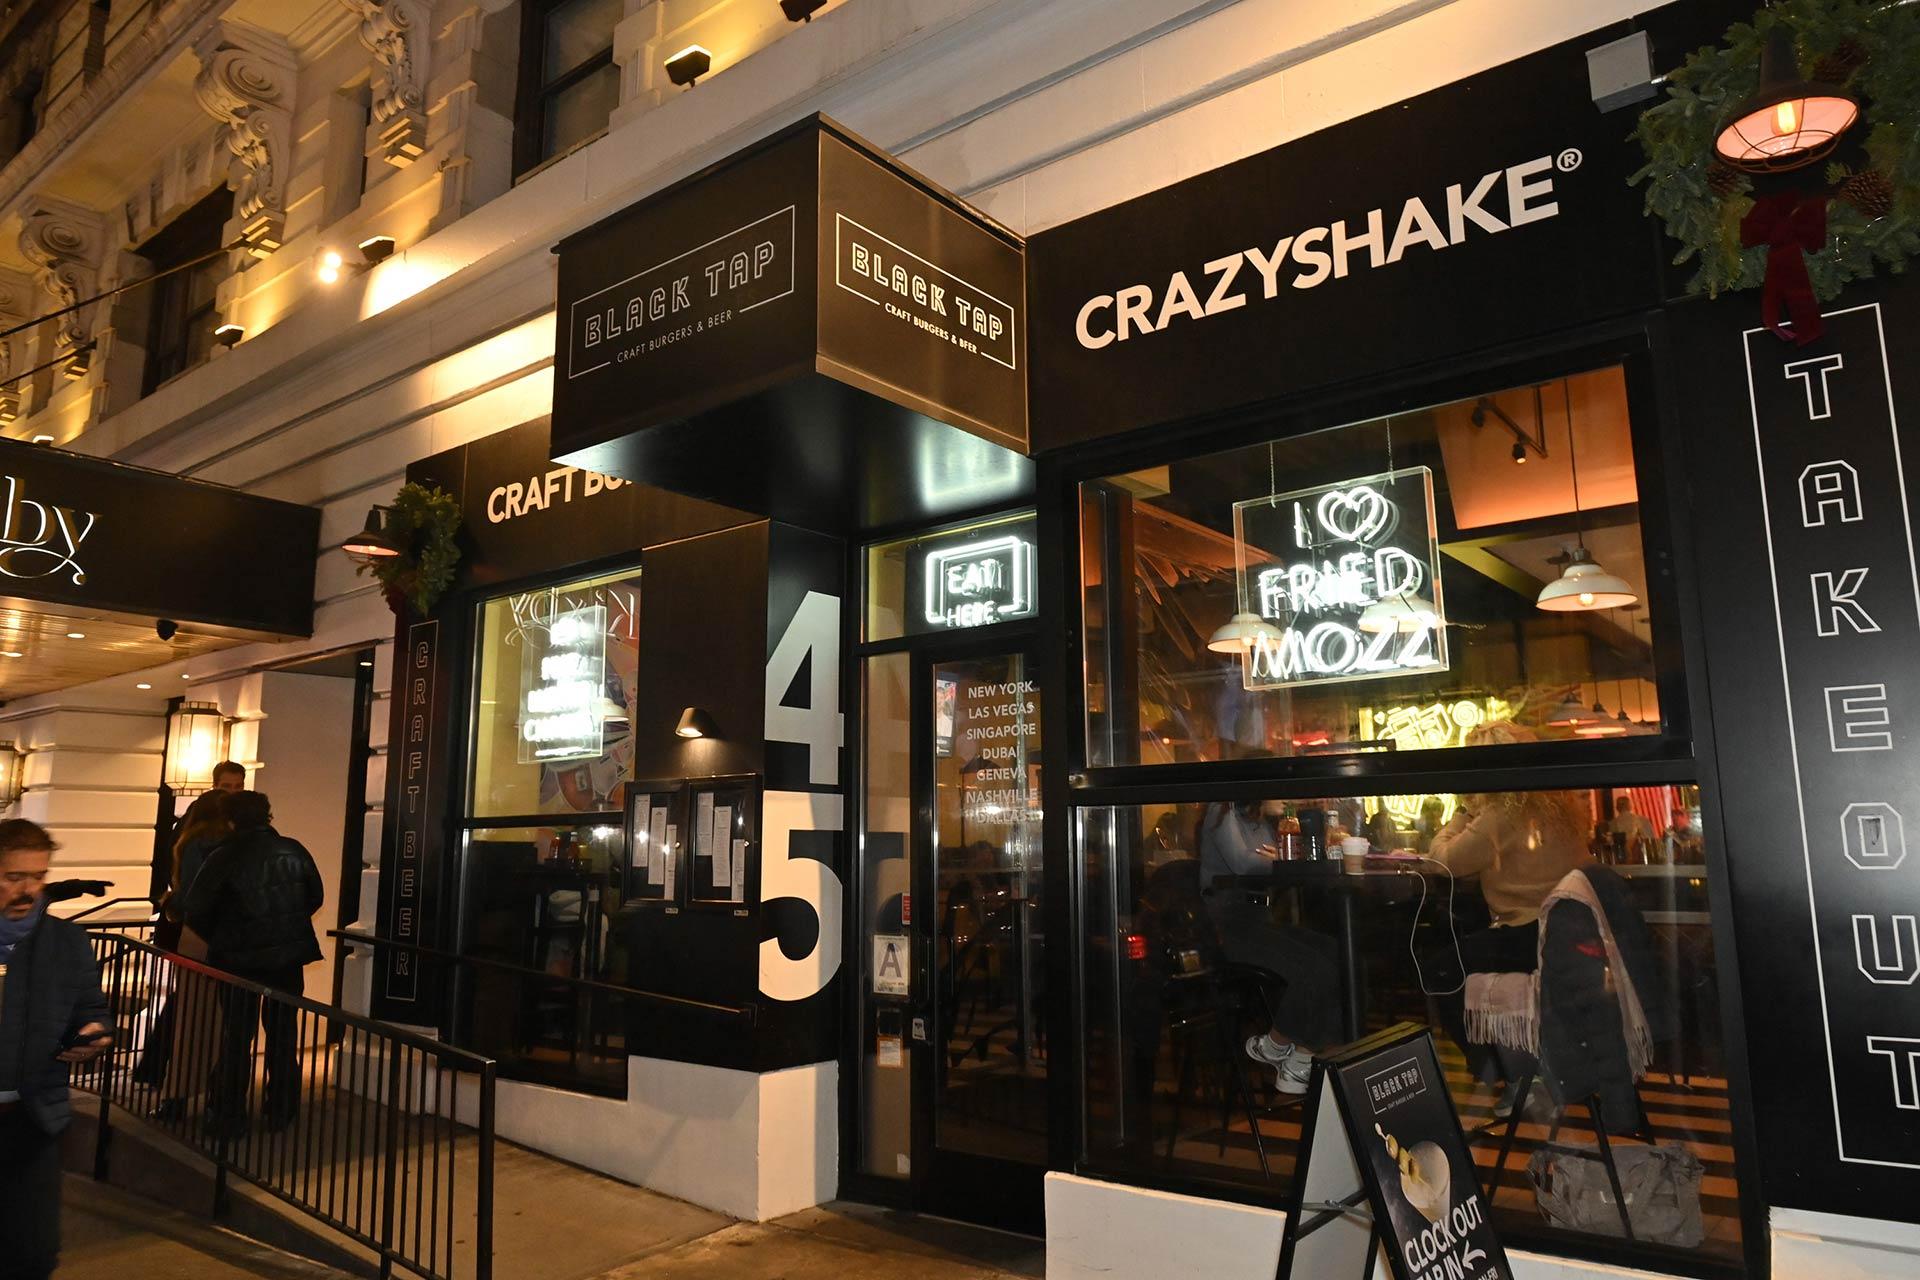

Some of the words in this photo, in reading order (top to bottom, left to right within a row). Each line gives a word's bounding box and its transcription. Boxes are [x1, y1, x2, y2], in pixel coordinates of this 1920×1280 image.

[585, 276, 690, 348] BLACK
[705, 240, 774, 297] TAP
[852, 242, 947, 316] BLACK
[955, 296, 1003, 341] TAP
[616, 342, 646, 363] CRAFT
[649, 324, 693, 351] BURGERS
[696, 320, 704, 332] &
[708, 309, 732, 328] BEER
[884, 302, 911, 323] CRAFT
[913, 315, 949, 341] BURGERS
[951, 334, 957, 345] &
[487, 466, 579, 524] CRAFT
[1293, 501, 1305, 548] I
[947, 558, 999, 594] EAT
[1252, 610, 1440, 679] MOZZ
[968, 684, 996, 699] NEW
[999, 680, 1033, 695] YORK
[408, 641, 428, 813] CRAFT
[968, 707, 990, 719] LAS
[993, 701, 1034, 717] VEGAS
[966, 723, 1036, 740] SINGAPORE
[982, 746, 1020, 760] DUBAI
[976, 767, 1027, 781] GENEVA
[966, 788, 1038, 804] NASHVILLE
[977, 809, 1028, 825] DALLAS
[396, 830, 416, 976] BEER
[878, 943, 902, 978] A
[1371, 1075, 1403, 1101] BLACK
[1401, 1068, 1418, 1087] TAP
[1404, 1215, 1457, 1273] CLOCK
[1452, 1194, 1483, 1238] OUT
